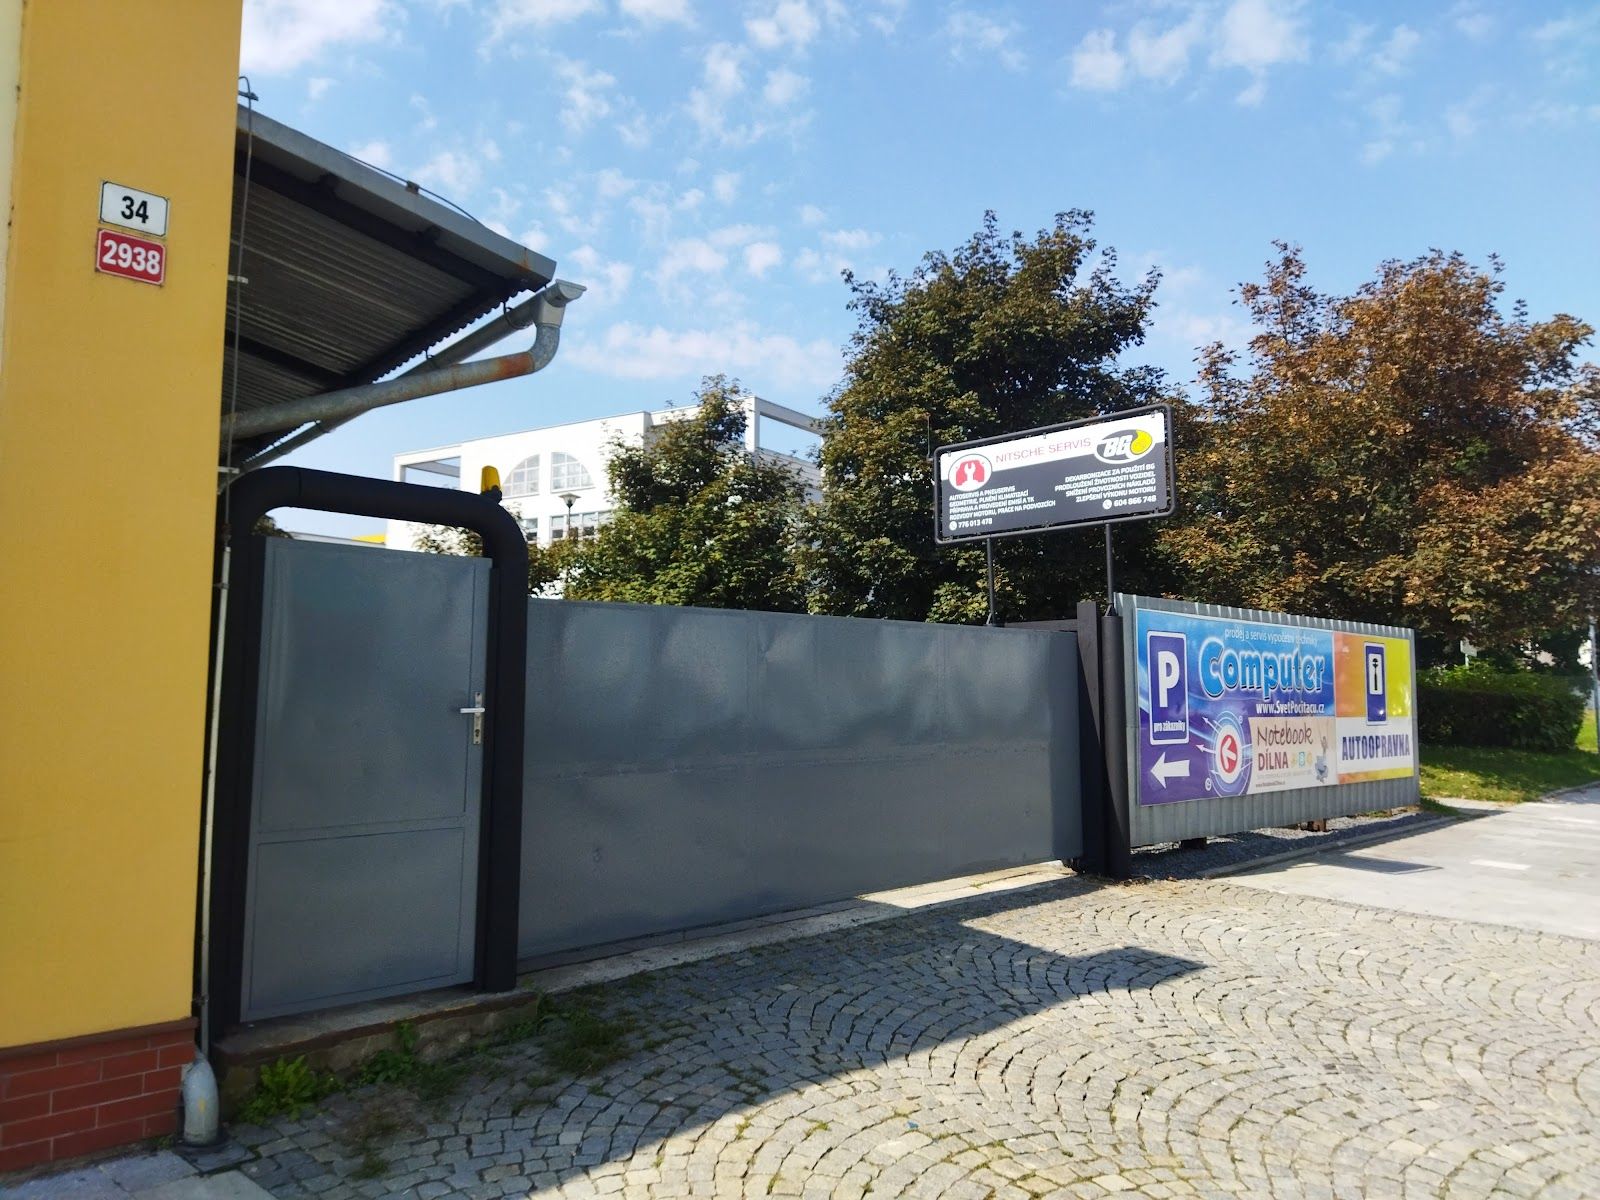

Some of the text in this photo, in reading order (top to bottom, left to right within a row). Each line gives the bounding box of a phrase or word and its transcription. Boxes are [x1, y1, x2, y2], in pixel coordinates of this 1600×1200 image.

[121, 195, 149, 224] 34
[102, 239, 160, 275] 2938
[995, 437, 1091, 462] NITSCHE SERVIS
[1055, 470, 1156, 492] PRODLOUŽENÍ ŽIVOTNOSTI VOZIDEL
[1065, 469, 1111, 483] DEKARBONIZACE
[1121, 463, 1145, 474] POUŽITÍ
[949, 491, 979, 501] AUTOSERVIS
[984, 485, 1016, 496] PNEUSERVIS
[1066, 477, 1156, 497] SNÍŽENÍ PROVOZNÍCH NÁKLADŮ
[1076, 486, 1156, 503] ZLEPŠENÍ VÝKONU MOTORU
[949, 504, 973, 514] PŘÍPRAVA
[979, 500, 1007, 510] PROVEDENÍ
[979, 494, 997, 504] PLNĚNÍ
[1113, 499, 1127, 507] 604
[1142, 495, 1157, 503] 748
[949, 512, 973, 521] ROZVODY
[973, 508, 996, 518] MOTORU,
[998, 505, 1014, 514] PRÁCE
[1023, 500, 1056, 511] PODVOZCÍCH
[970, 519, 980, 527] 013
[1224, 627, 1244, 641] prodej
[1245, 631, 1250, 639] a
[1250, 630, 1267, 641] servis
[1199, 636, 1325, 700] Computer
[1158, 651, 1180, 708] P
[1256, 701, 1325, 714] www.SvetPocitacu.cz
[1153, 720, 1186, 733] pro zákazníky
[1257, 721, 1313, 746] Notebook
[1342, 733, 1411, 761] AUTOOPRAVNA
[1258, 748, 1289, 771] DÍLNA
